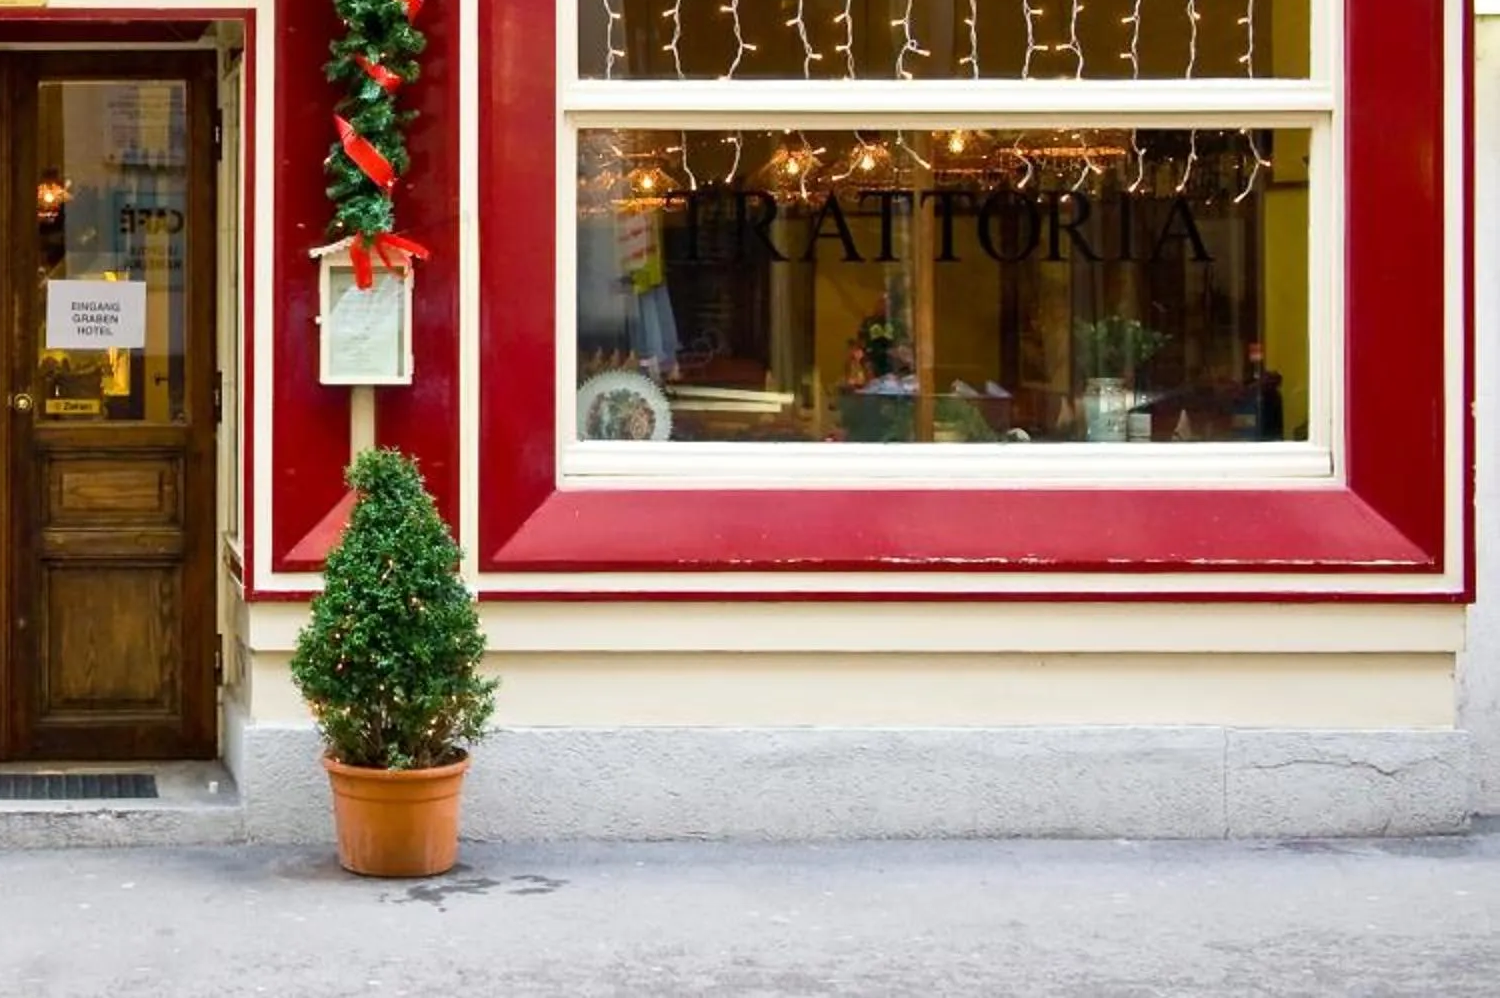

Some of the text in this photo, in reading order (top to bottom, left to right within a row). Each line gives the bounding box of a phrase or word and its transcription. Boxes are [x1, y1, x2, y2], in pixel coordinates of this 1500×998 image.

[668, 190, 1214, 263] TRATTORIA
[71, 301, 121, 312] EINGANG
[71, 313, 119, 324] GRABEN
[77, 325, 113, 336] HOTEL
